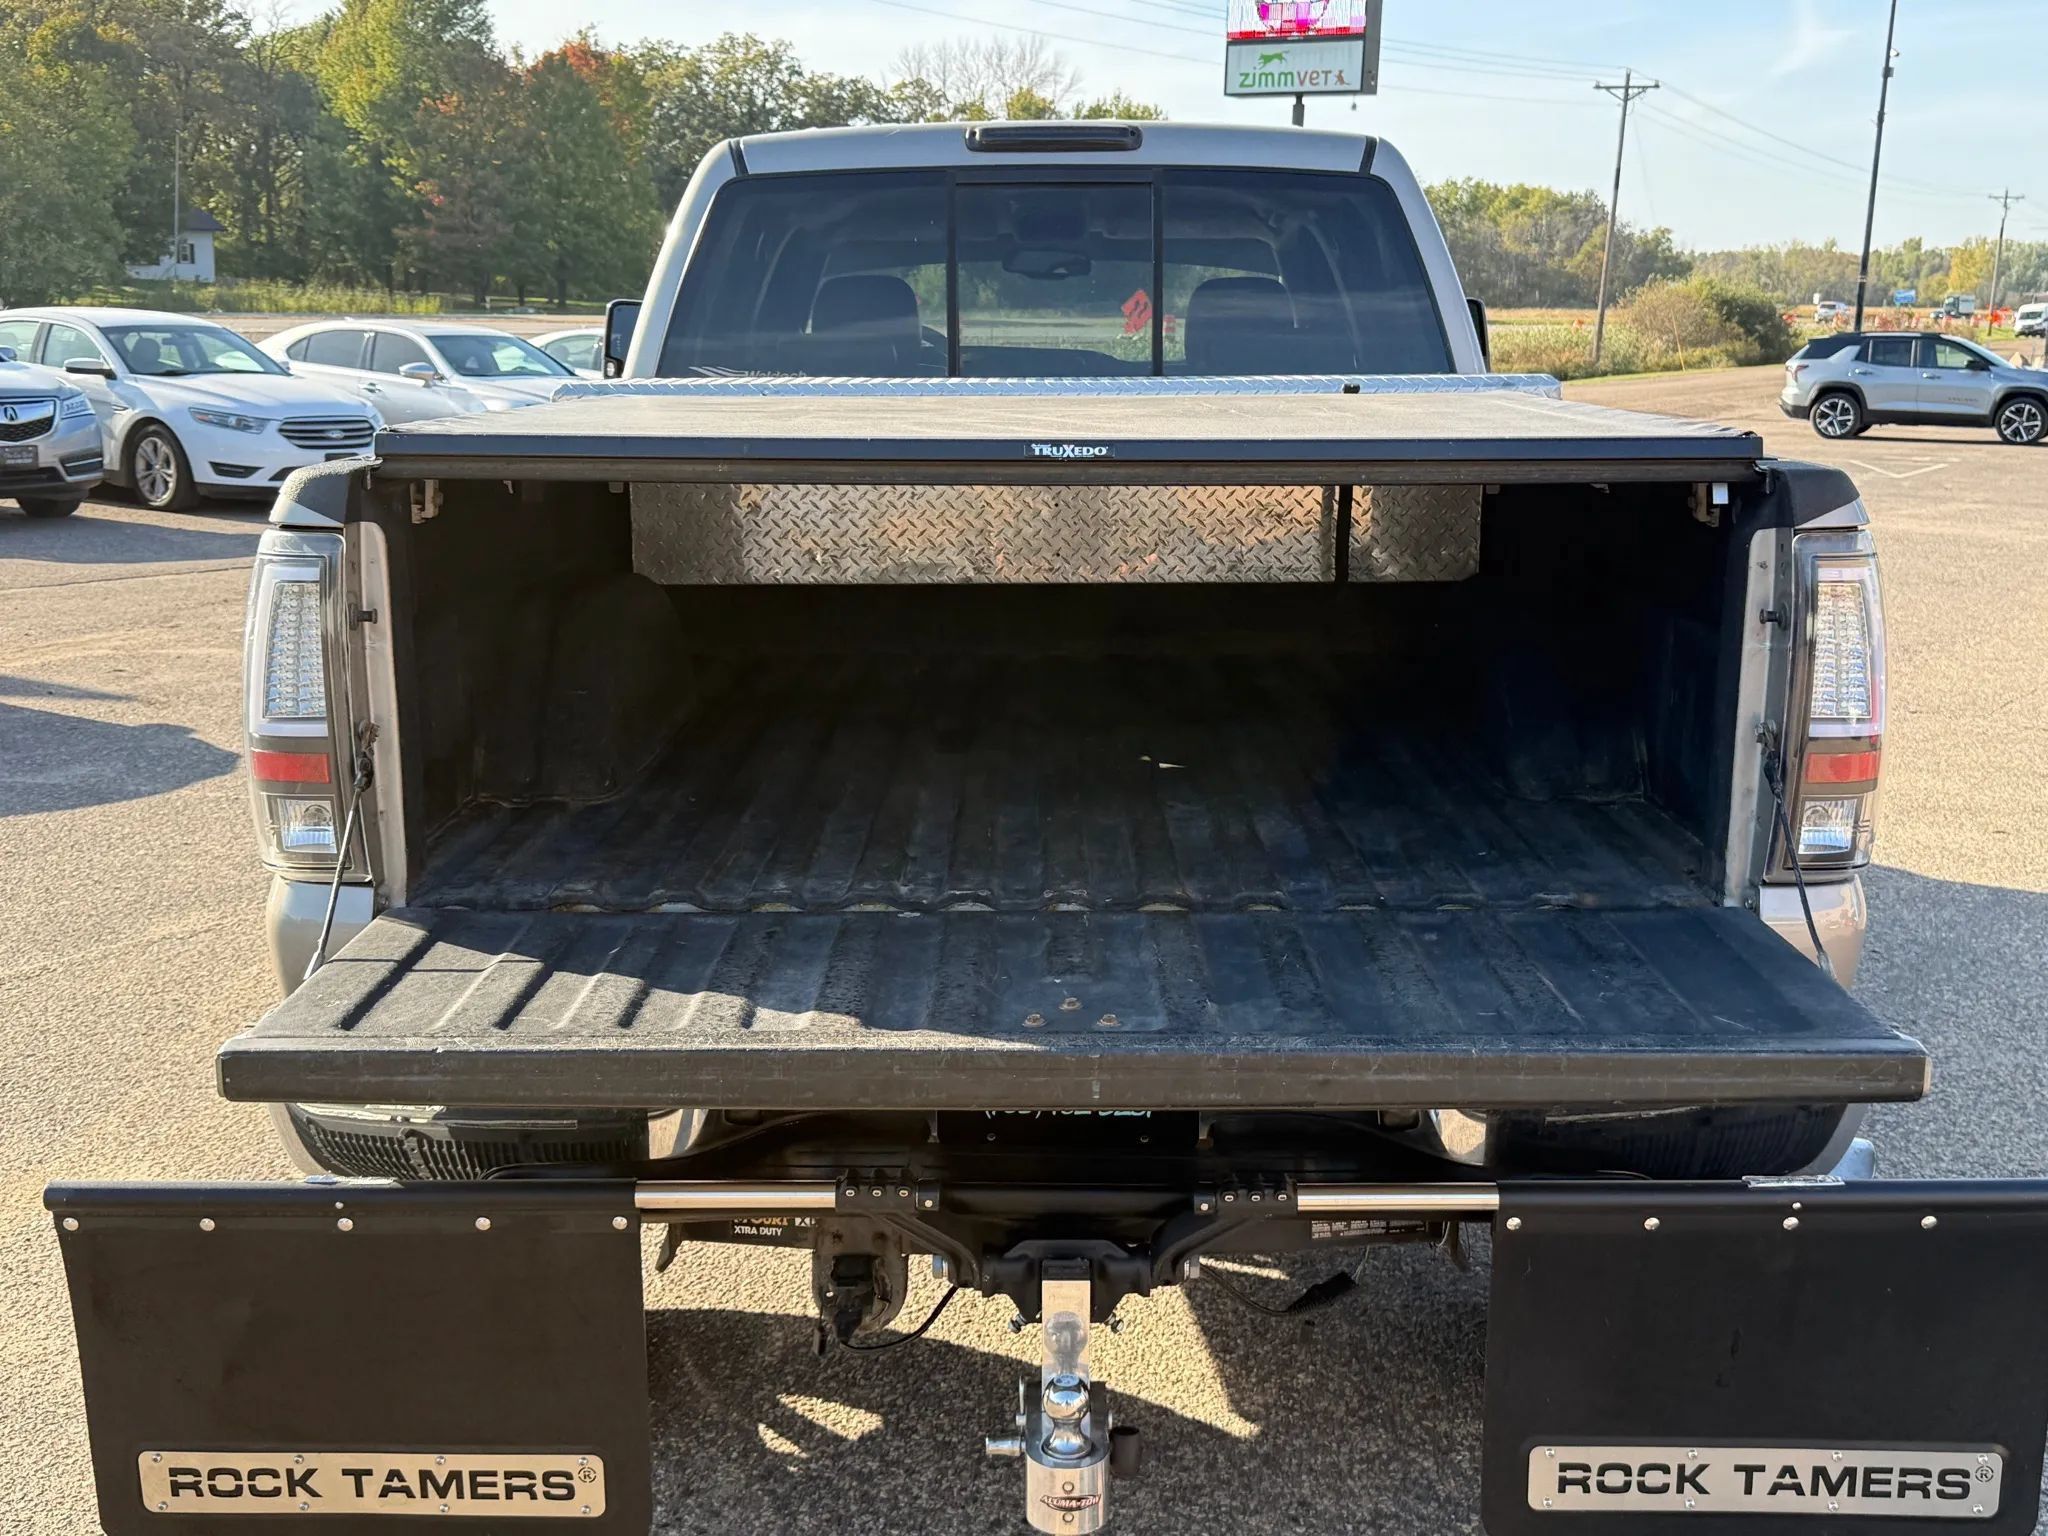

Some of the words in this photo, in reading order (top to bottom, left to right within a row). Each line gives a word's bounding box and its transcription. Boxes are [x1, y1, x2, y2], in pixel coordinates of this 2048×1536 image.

[734, 1225, 758, 1235] XTRA
[759, 1226, 783, 1236] DUTY
[167, 1466, 323, 1499] ROCK
[1557, 1462, 1711, 1496] ROCK
